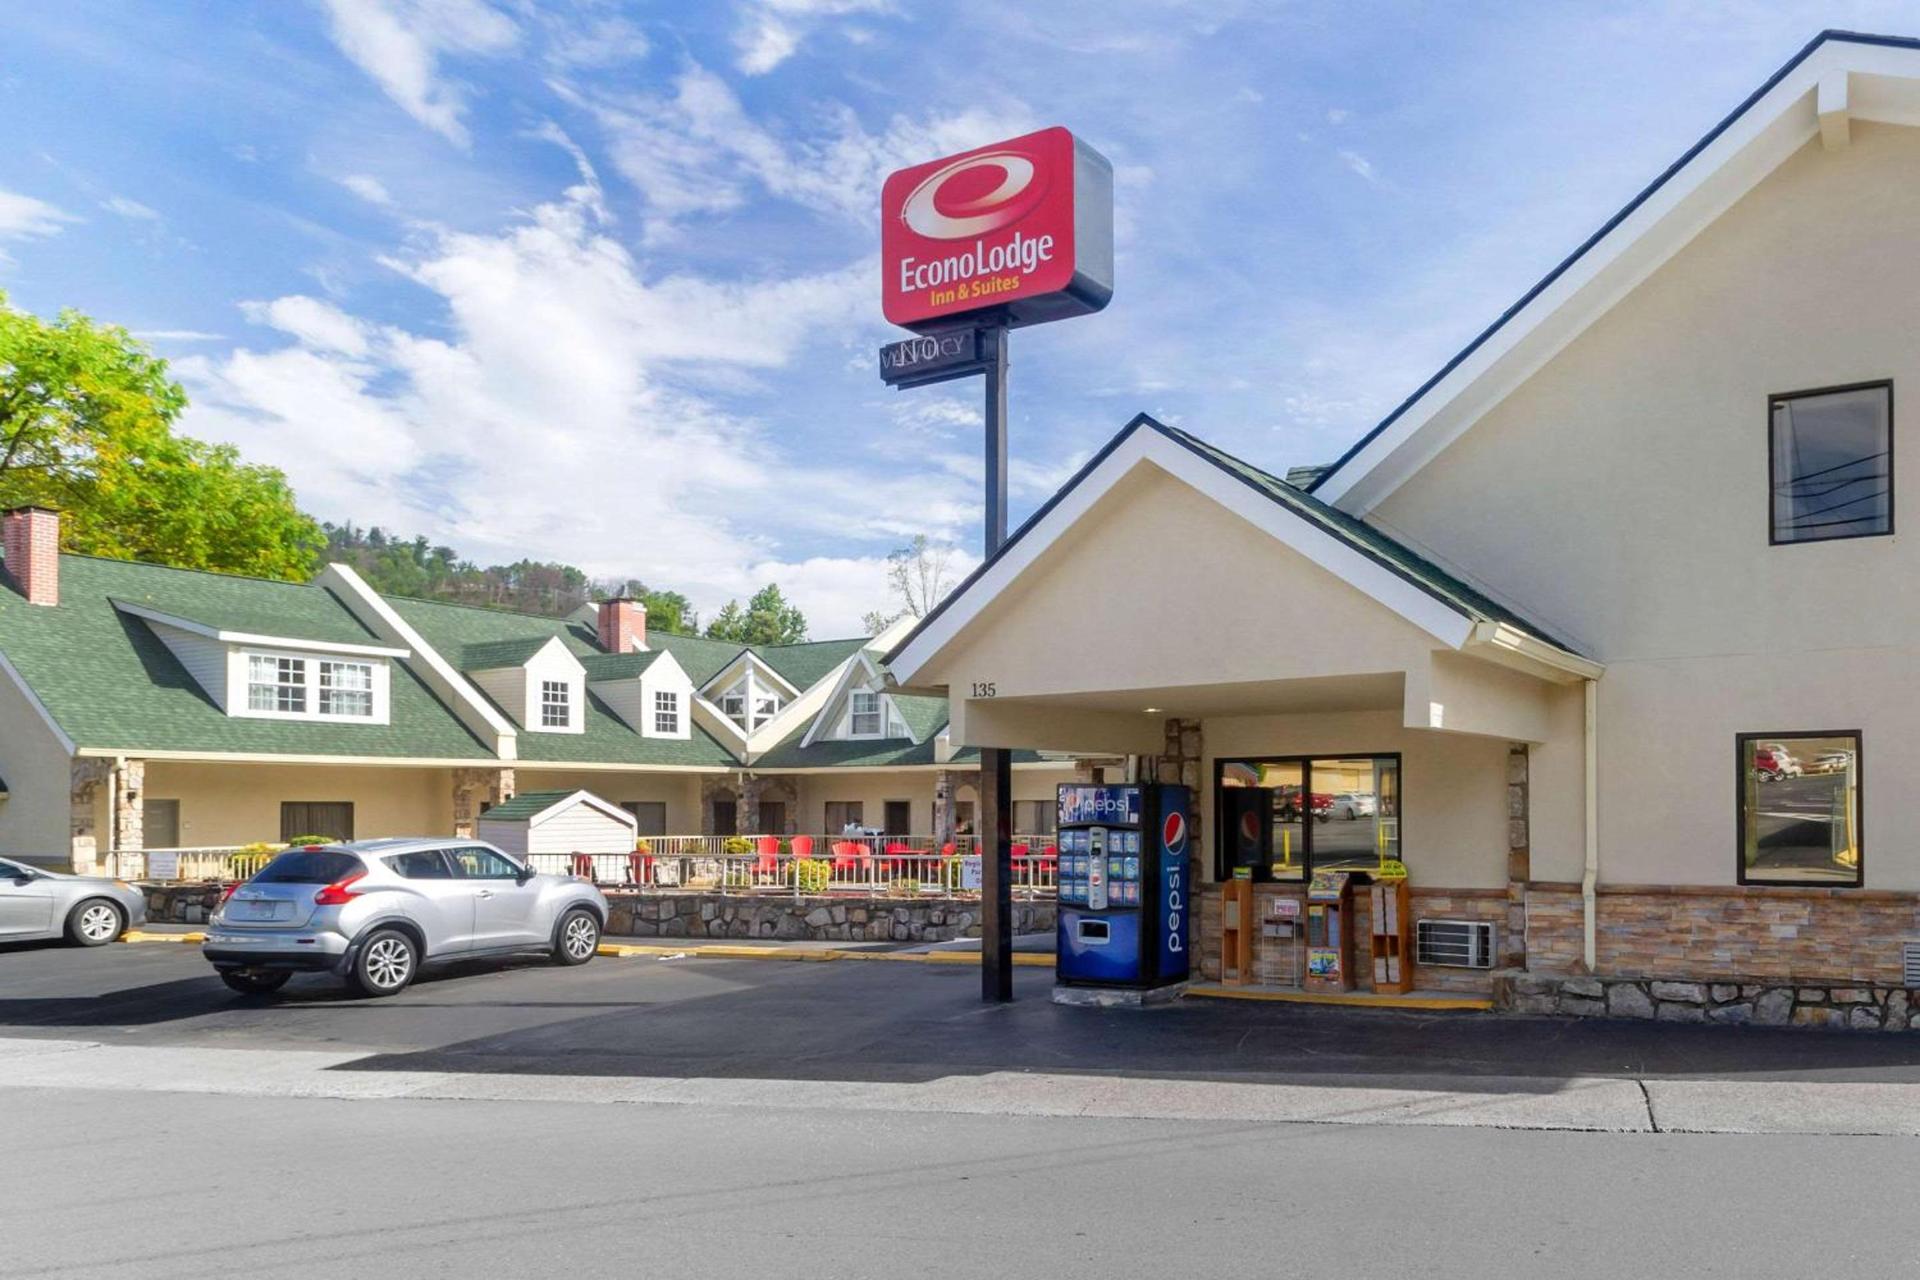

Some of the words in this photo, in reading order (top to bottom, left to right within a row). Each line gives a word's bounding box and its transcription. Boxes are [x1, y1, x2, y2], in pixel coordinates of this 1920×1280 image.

[901, 231, 1053, 293] EconoLodge
[931, 290, 955, 307] Inn
[957, 283, 970, 301] &
[972, 275, 1020, 297] Suites
[972, 682, 996, 697] 135
[1166, 866, 1183, 953] pepsi
